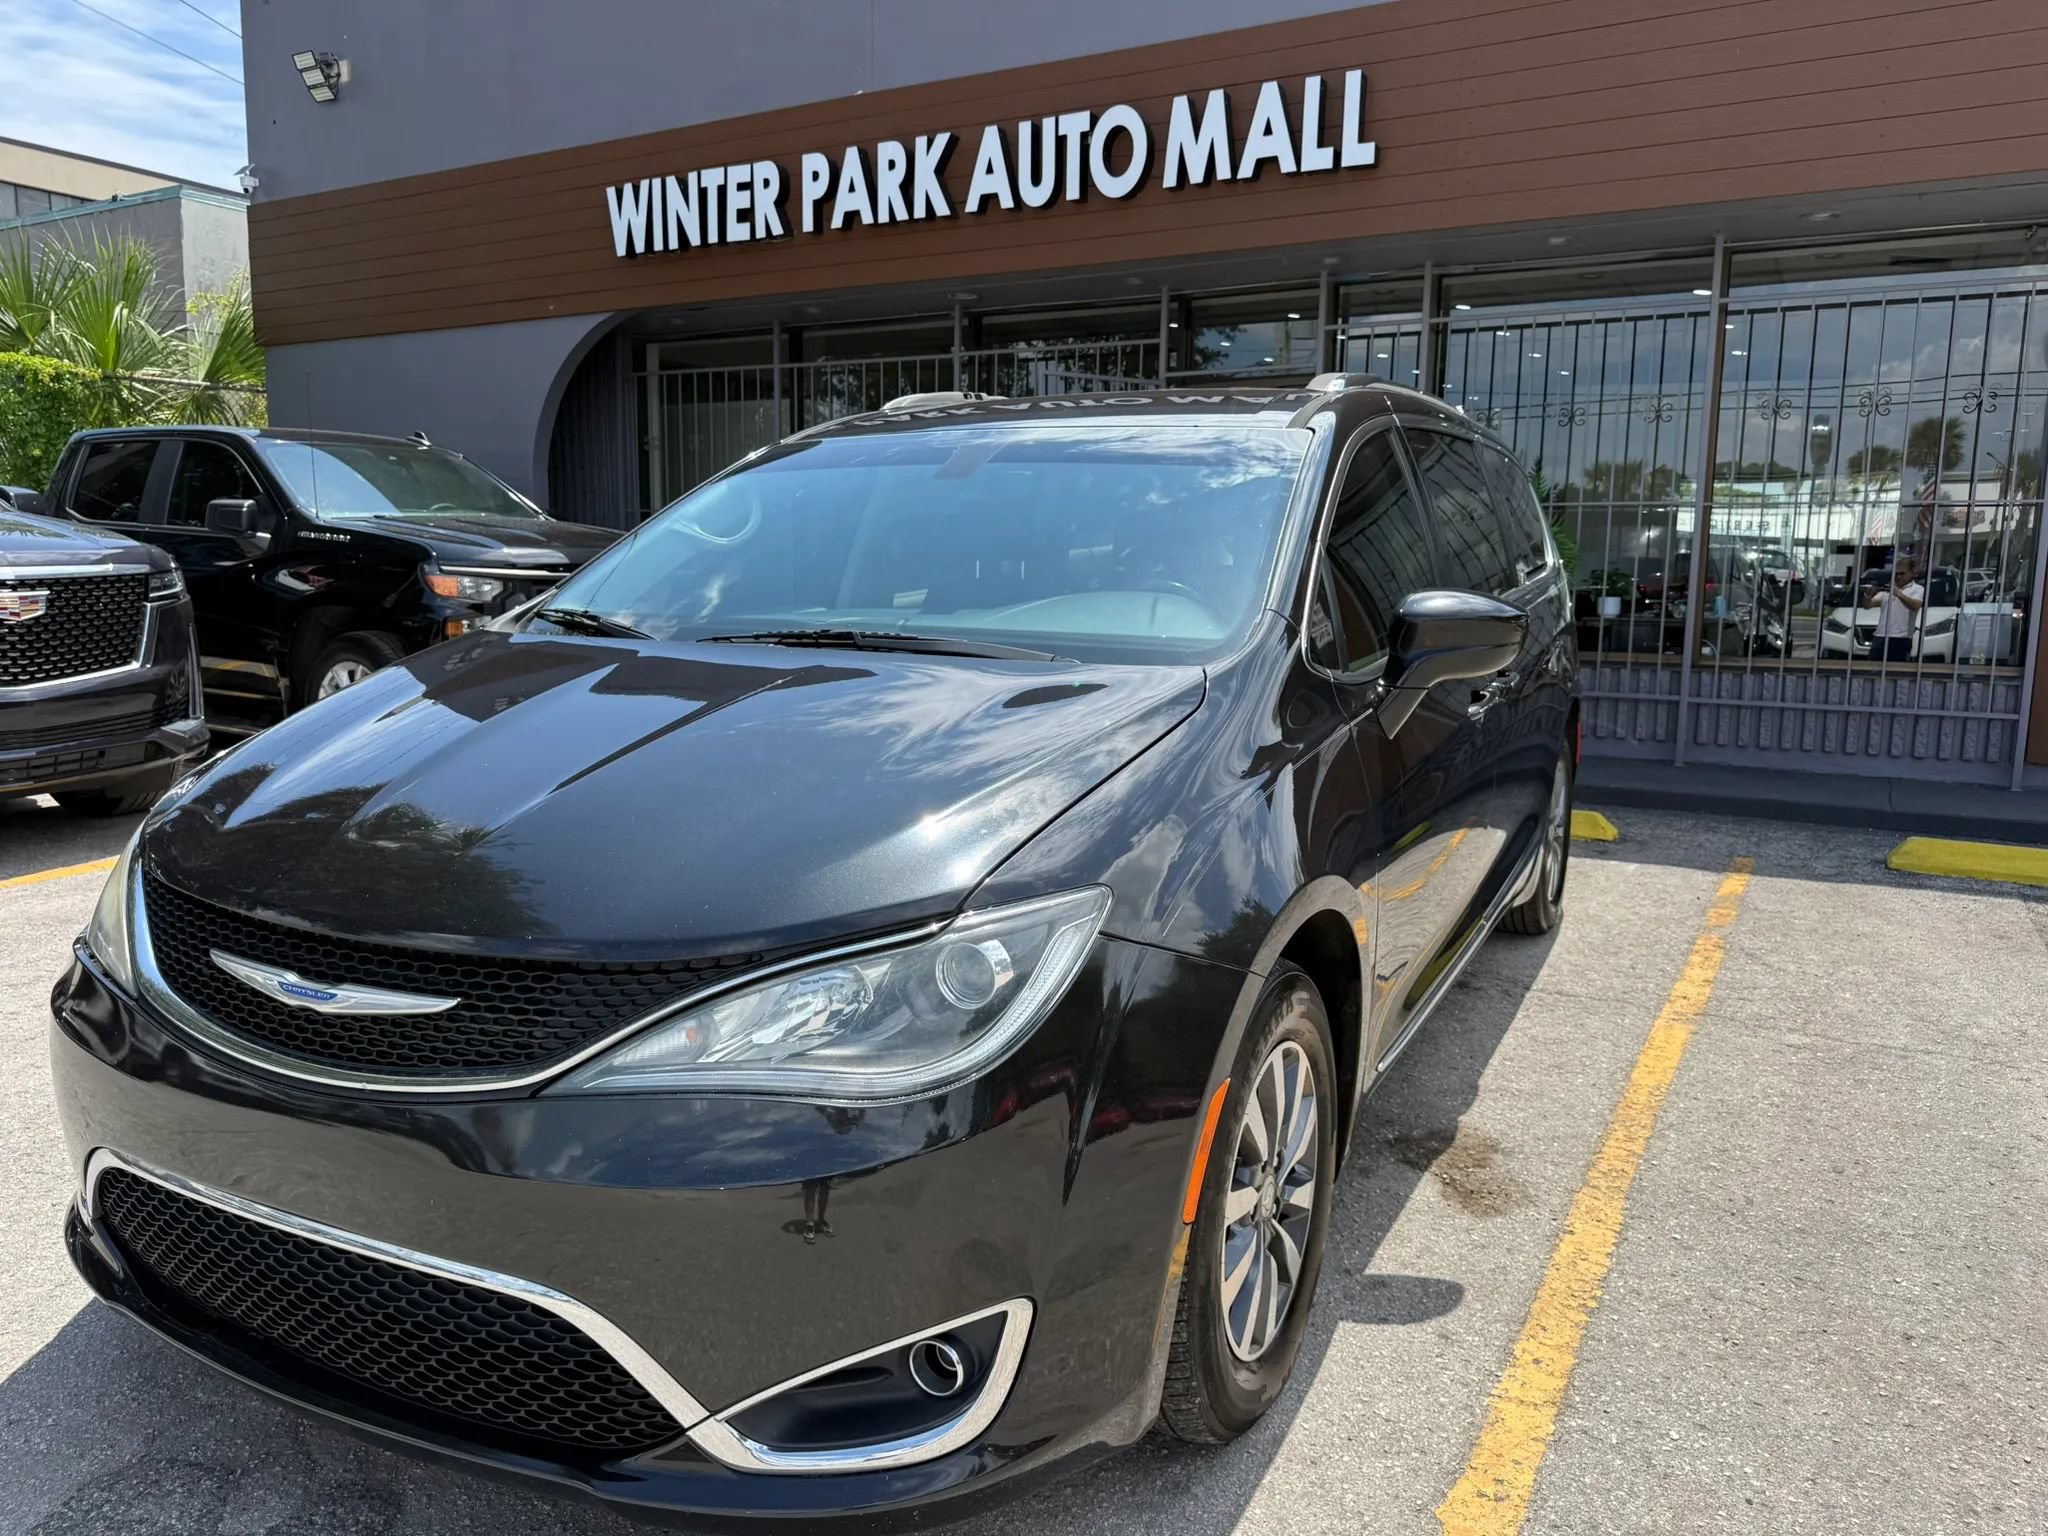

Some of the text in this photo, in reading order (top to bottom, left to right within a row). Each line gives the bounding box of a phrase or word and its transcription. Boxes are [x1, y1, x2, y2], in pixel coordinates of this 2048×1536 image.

[606, 69, 1376, 257] WINTER PARK AUTO MALL
[282, 984, 330, 1000] CHRYSLER
